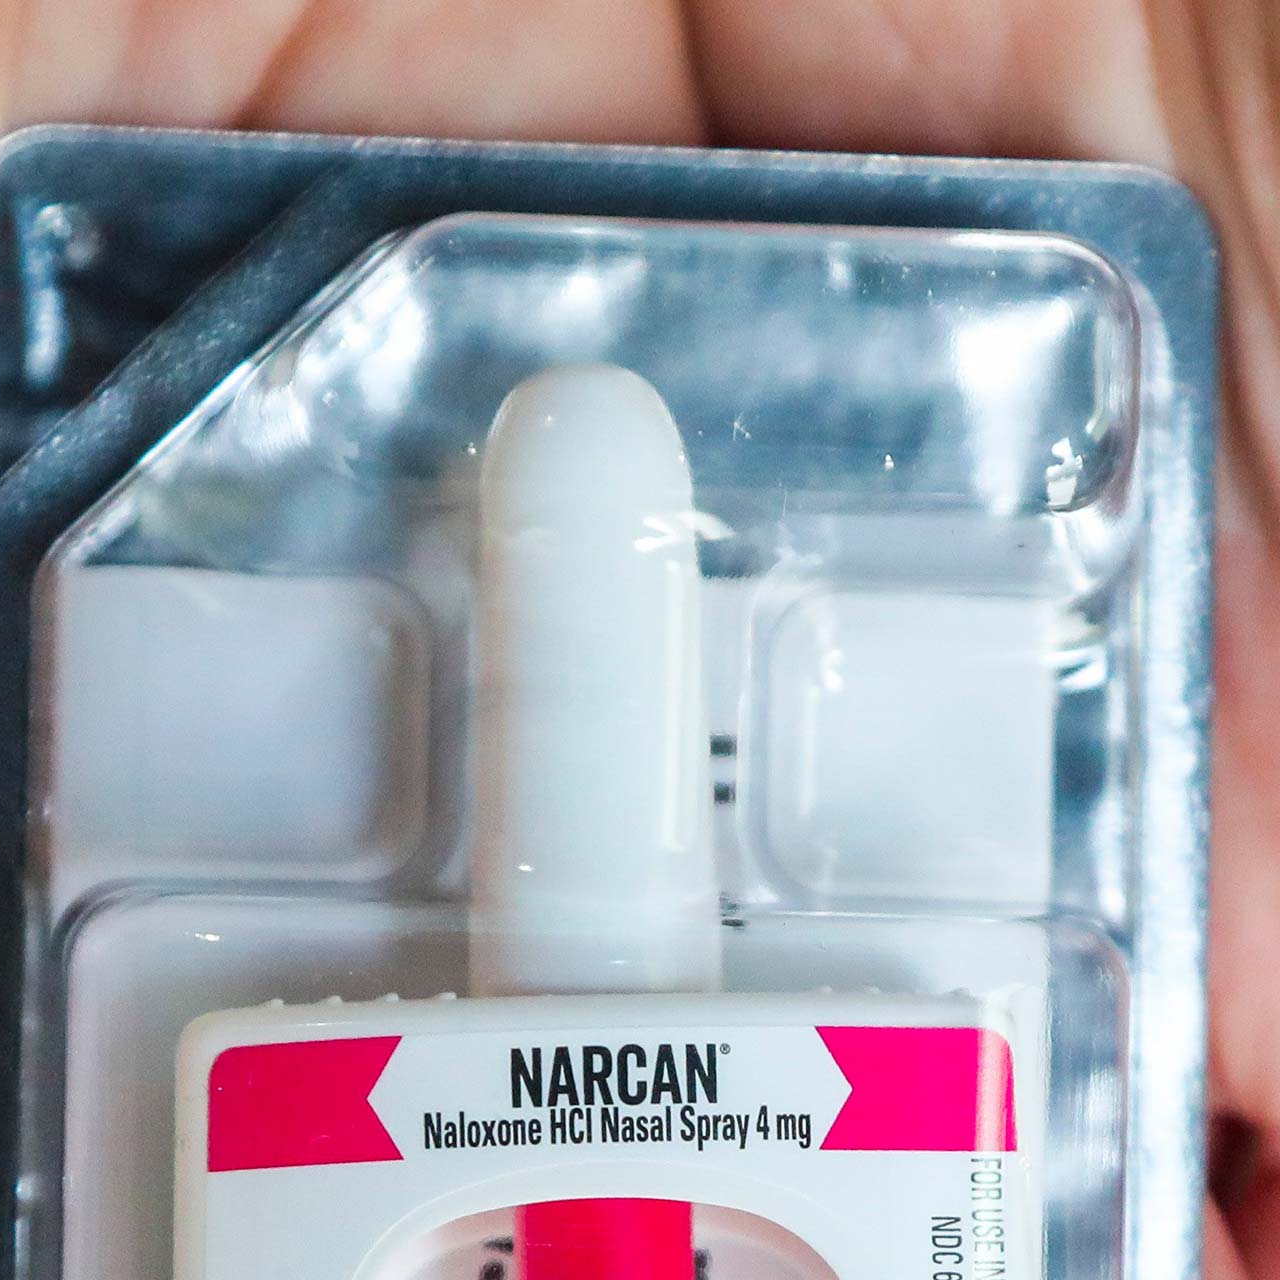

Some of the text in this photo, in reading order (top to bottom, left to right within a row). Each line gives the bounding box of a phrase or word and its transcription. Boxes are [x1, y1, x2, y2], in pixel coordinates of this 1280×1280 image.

[423, 1110, 543, 1149] Naloxone
[600, 1105, 672, 1143] Nasal
[679, 1104, 750, 1151] Spray
[755, 1104, 771, 1141] 4
[775, 1113, 812, 1149] mg
[970, 1157, 1003, 1201] FOR
[930, 1216, 964, 1265] NDC
[971, 1208, 1005, 1253] USE
